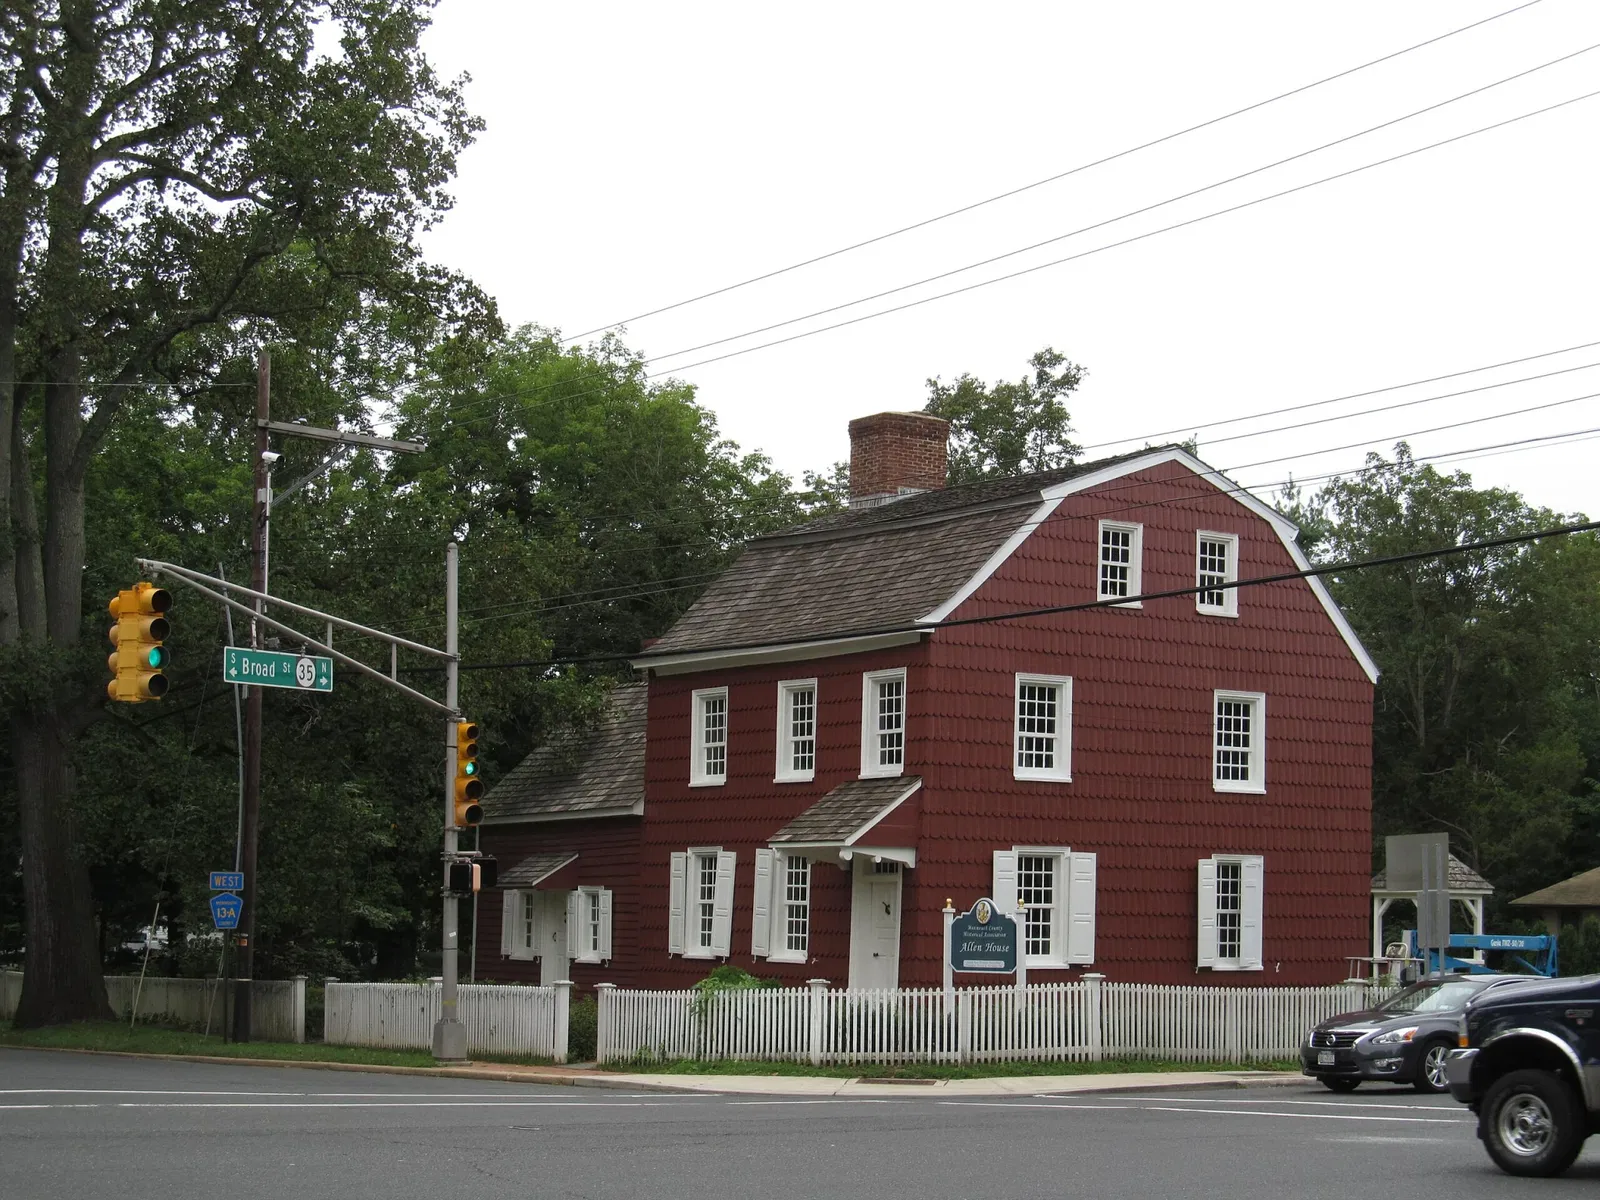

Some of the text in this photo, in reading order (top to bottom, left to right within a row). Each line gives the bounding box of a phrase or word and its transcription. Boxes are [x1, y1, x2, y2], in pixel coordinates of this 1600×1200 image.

[231, 652, 236, 664] S
[242, 657, 291, 678] Broad St
[299, 664, 313, 681] 35
[321, 662, 327, 673] N
[214, 875, 240, 887] WEST
[960, 941, 1010, 953] Allen House
